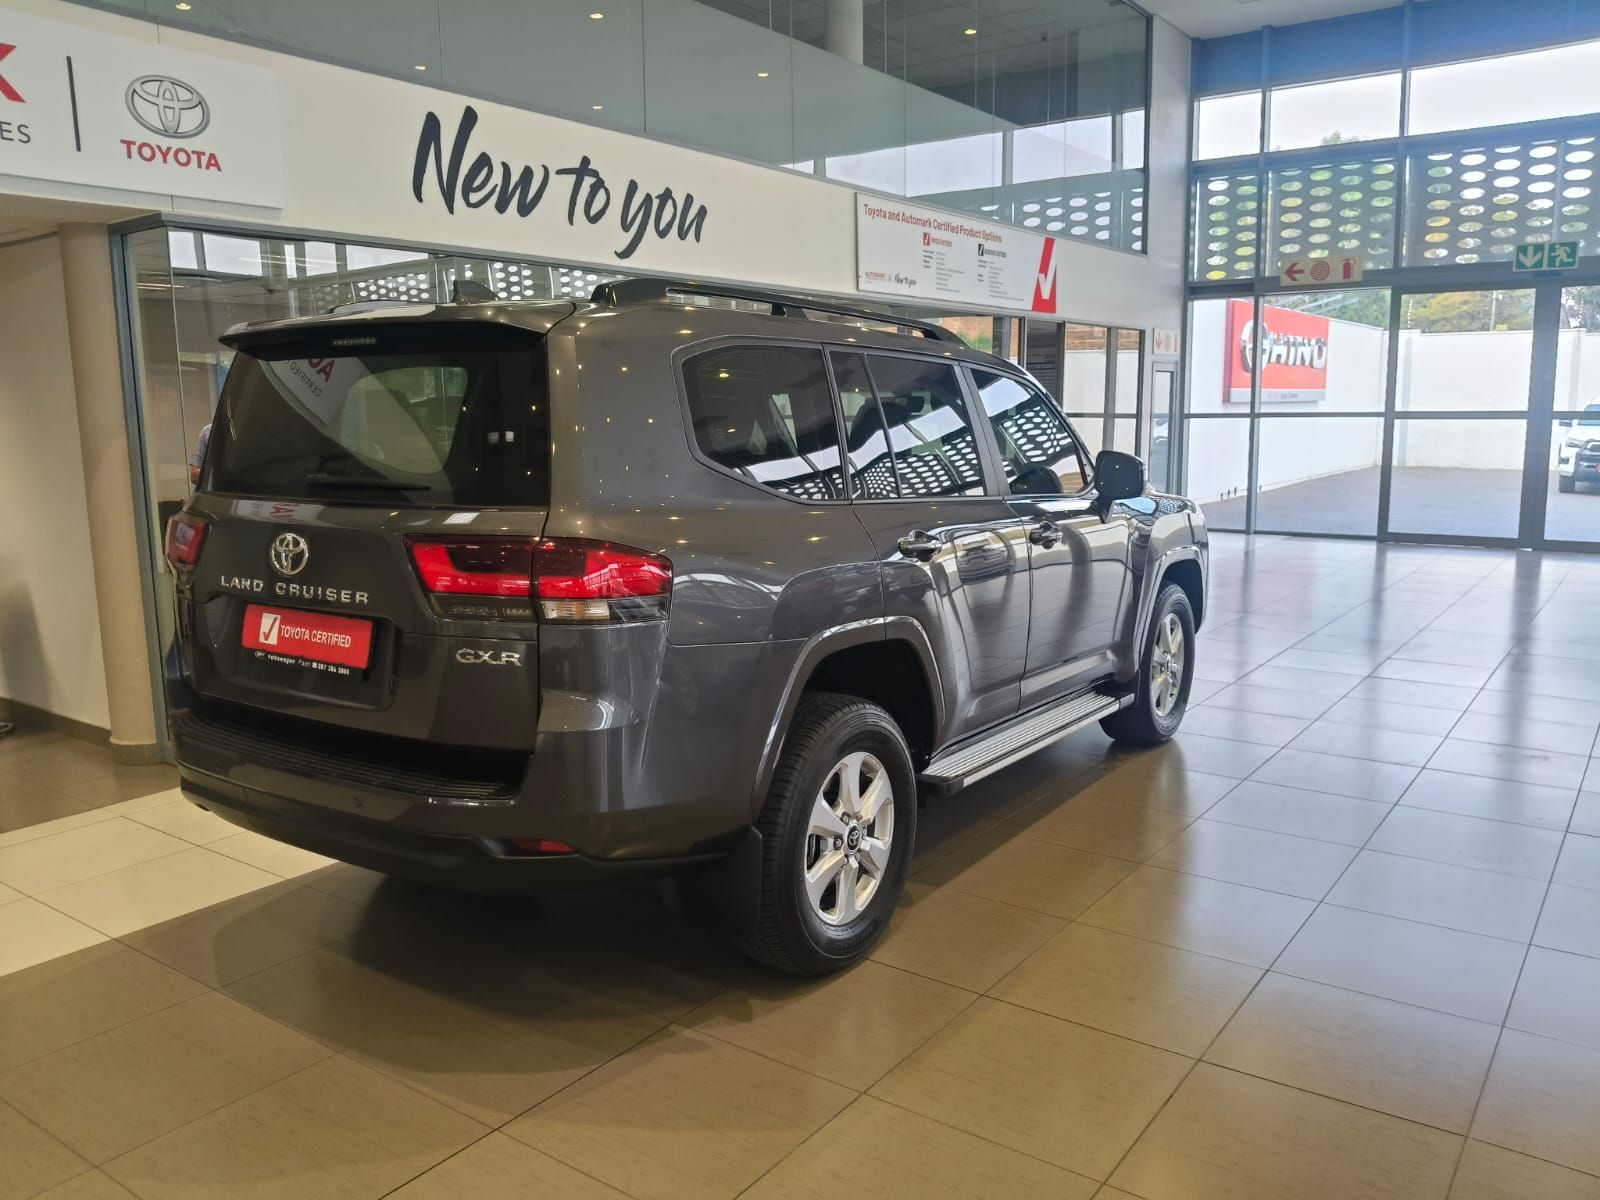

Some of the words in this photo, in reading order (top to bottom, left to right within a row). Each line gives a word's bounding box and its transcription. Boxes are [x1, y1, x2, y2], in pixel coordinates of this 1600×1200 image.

[120, 139, 222, 172] TOYOTA
[412, 105, 549, 218] New
[555, 155, 611, 226] to
[614, 178, 708, 260] you
[864, 203, 886, 219] Toyota
[887, 211, 901, 221] and
[901, 212, 932, 228] Automark
[933, 219, 959, 234] Certified
[960, 225, 981, 238] Product
[982, 230, 1002, 243] Options
[220, 575, 264, 592] LAND
[275, 582, 369, 605] CRUISER
[281, 625, 310, 641] TOYOTA
[311, 630, 352, 648] CERTIFIED
[456, 647, 522, 667] GXR
